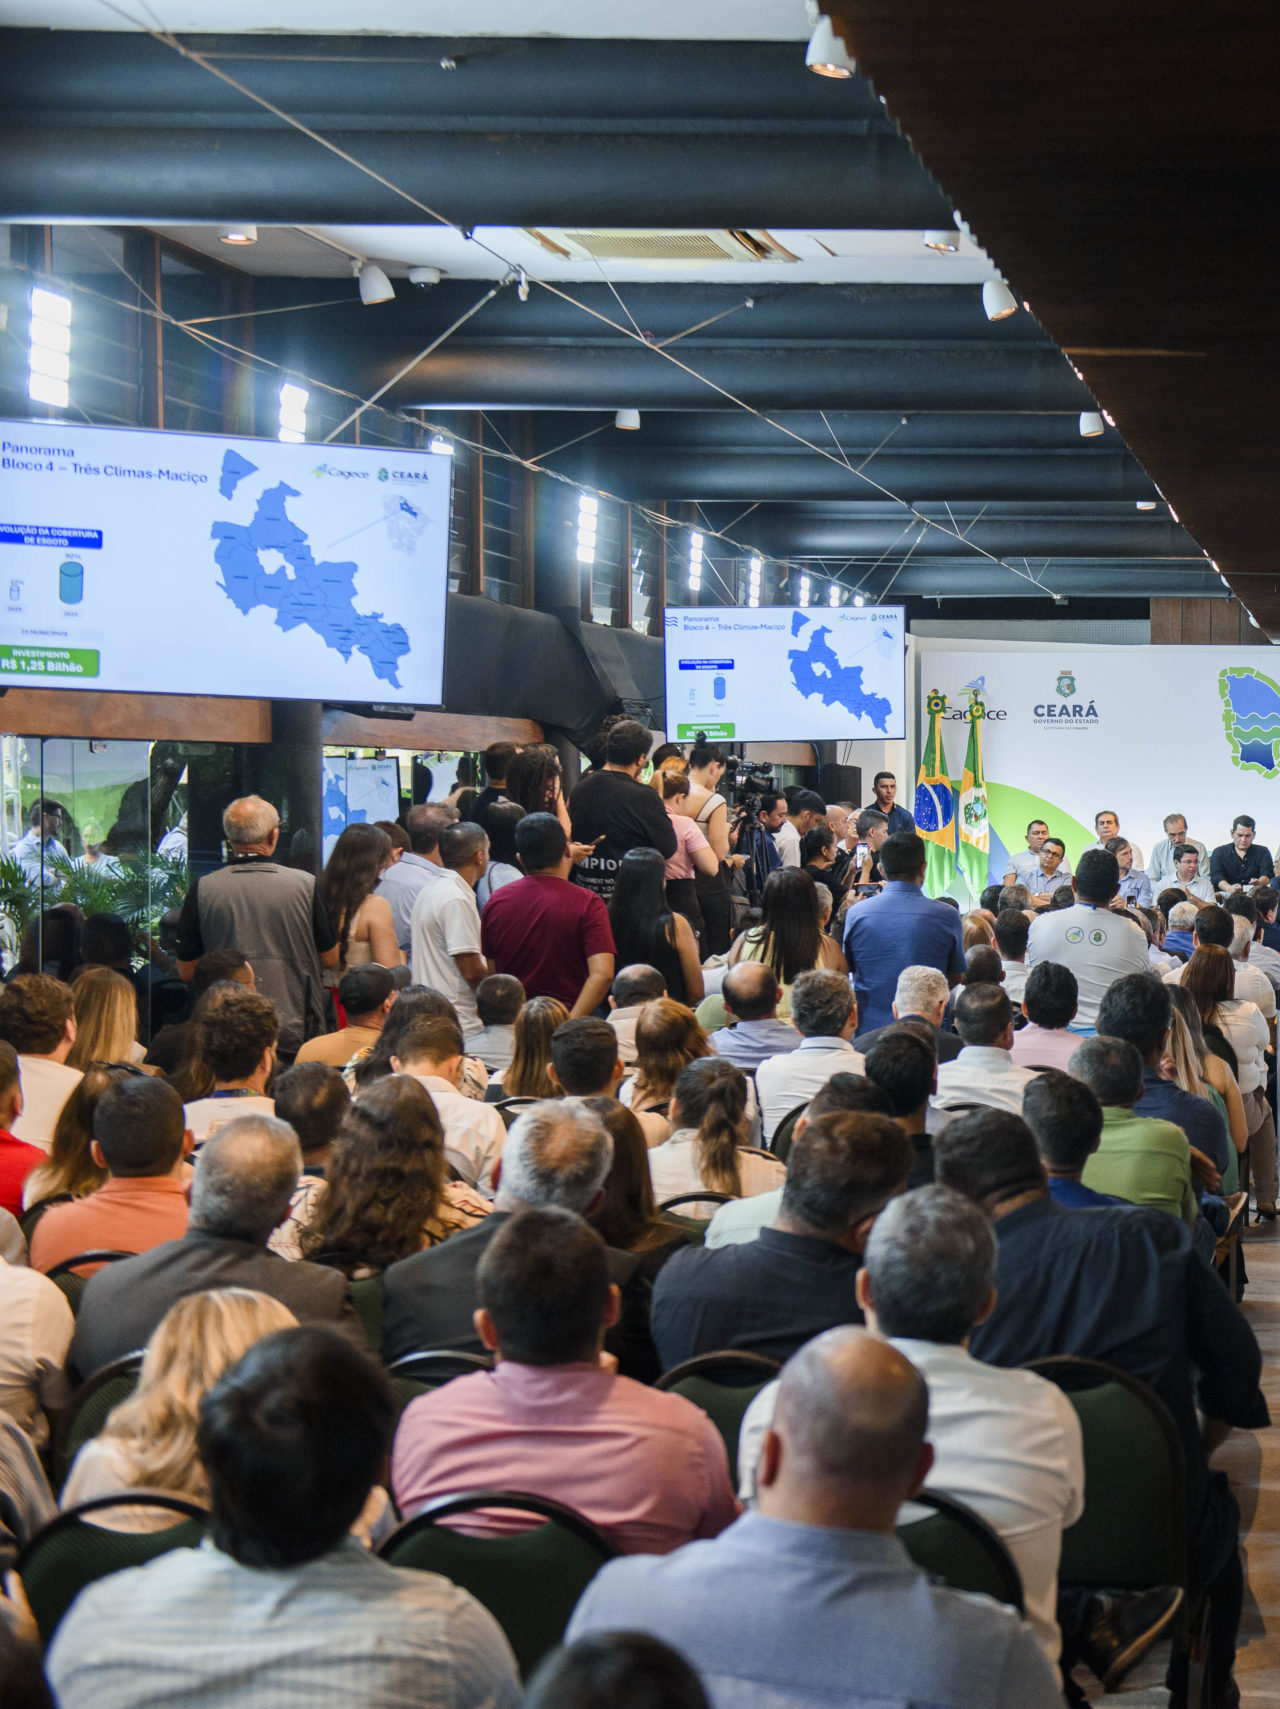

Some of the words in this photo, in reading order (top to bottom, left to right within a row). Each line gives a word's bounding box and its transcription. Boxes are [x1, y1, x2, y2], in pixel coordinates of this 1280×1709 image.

[2, 441, 75, 458] Panorama
[2, 458, 43, 471] Bloco
[45, 462, 54, 472] 4
[73, 463, 100, 475] Três
[104, 465, 208, 485] Climas-Maciço
[392, 469, 429, 480] CEARÁ
[0, 525, 37, 536] VOLUÇÃO
[39, 528, 49, 536] DA
[51, 529, 99, 539] COBERTURA
[24, 536, 35, 544] DE
[36, 537, 69, 546] ESGOTO
[12, 648, 70, 659] INVESTIMENTO
[1, 658, 17, 671] R$
[20, 660, 45, 672] 1,25
[47, 660, 84, 673] Bilhão
[942, 707, 1007, 724] Cagce
[1034, 700, 1098, 718] CEARÁ
